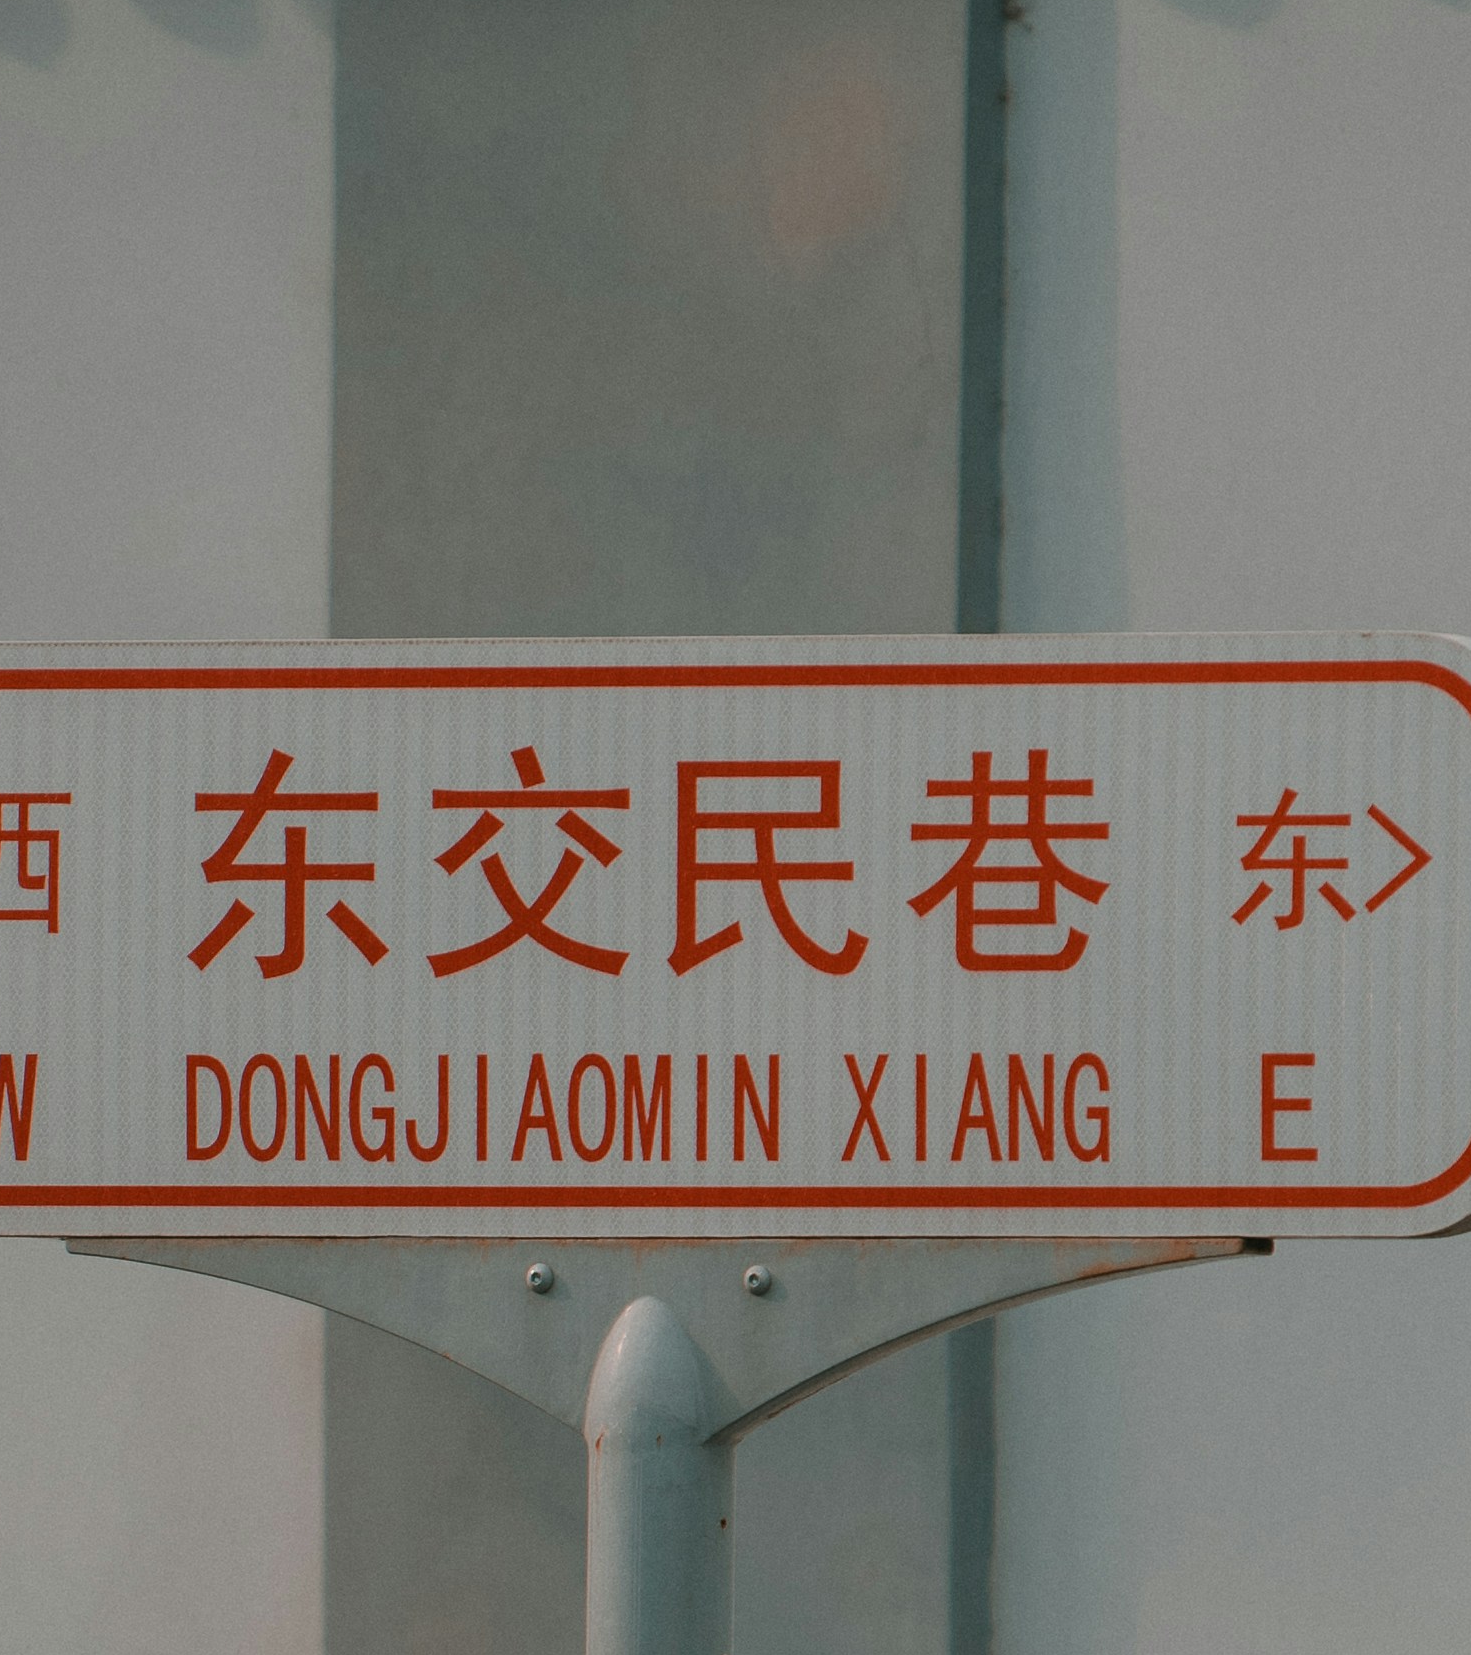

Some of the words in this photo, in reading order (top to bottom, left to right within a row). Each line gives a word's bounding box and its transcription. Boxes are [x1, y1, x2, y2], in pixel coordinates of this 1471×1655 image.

[187, 744, 1112, 981] 东交民巷
[1231, 787, 1357, 932] 东
[185, 1052, 782, 1164] DONGJIAOMIN
[840, 1051, 1111, 1163] XIANG
[1259, 1051, 1320, 1163] E
